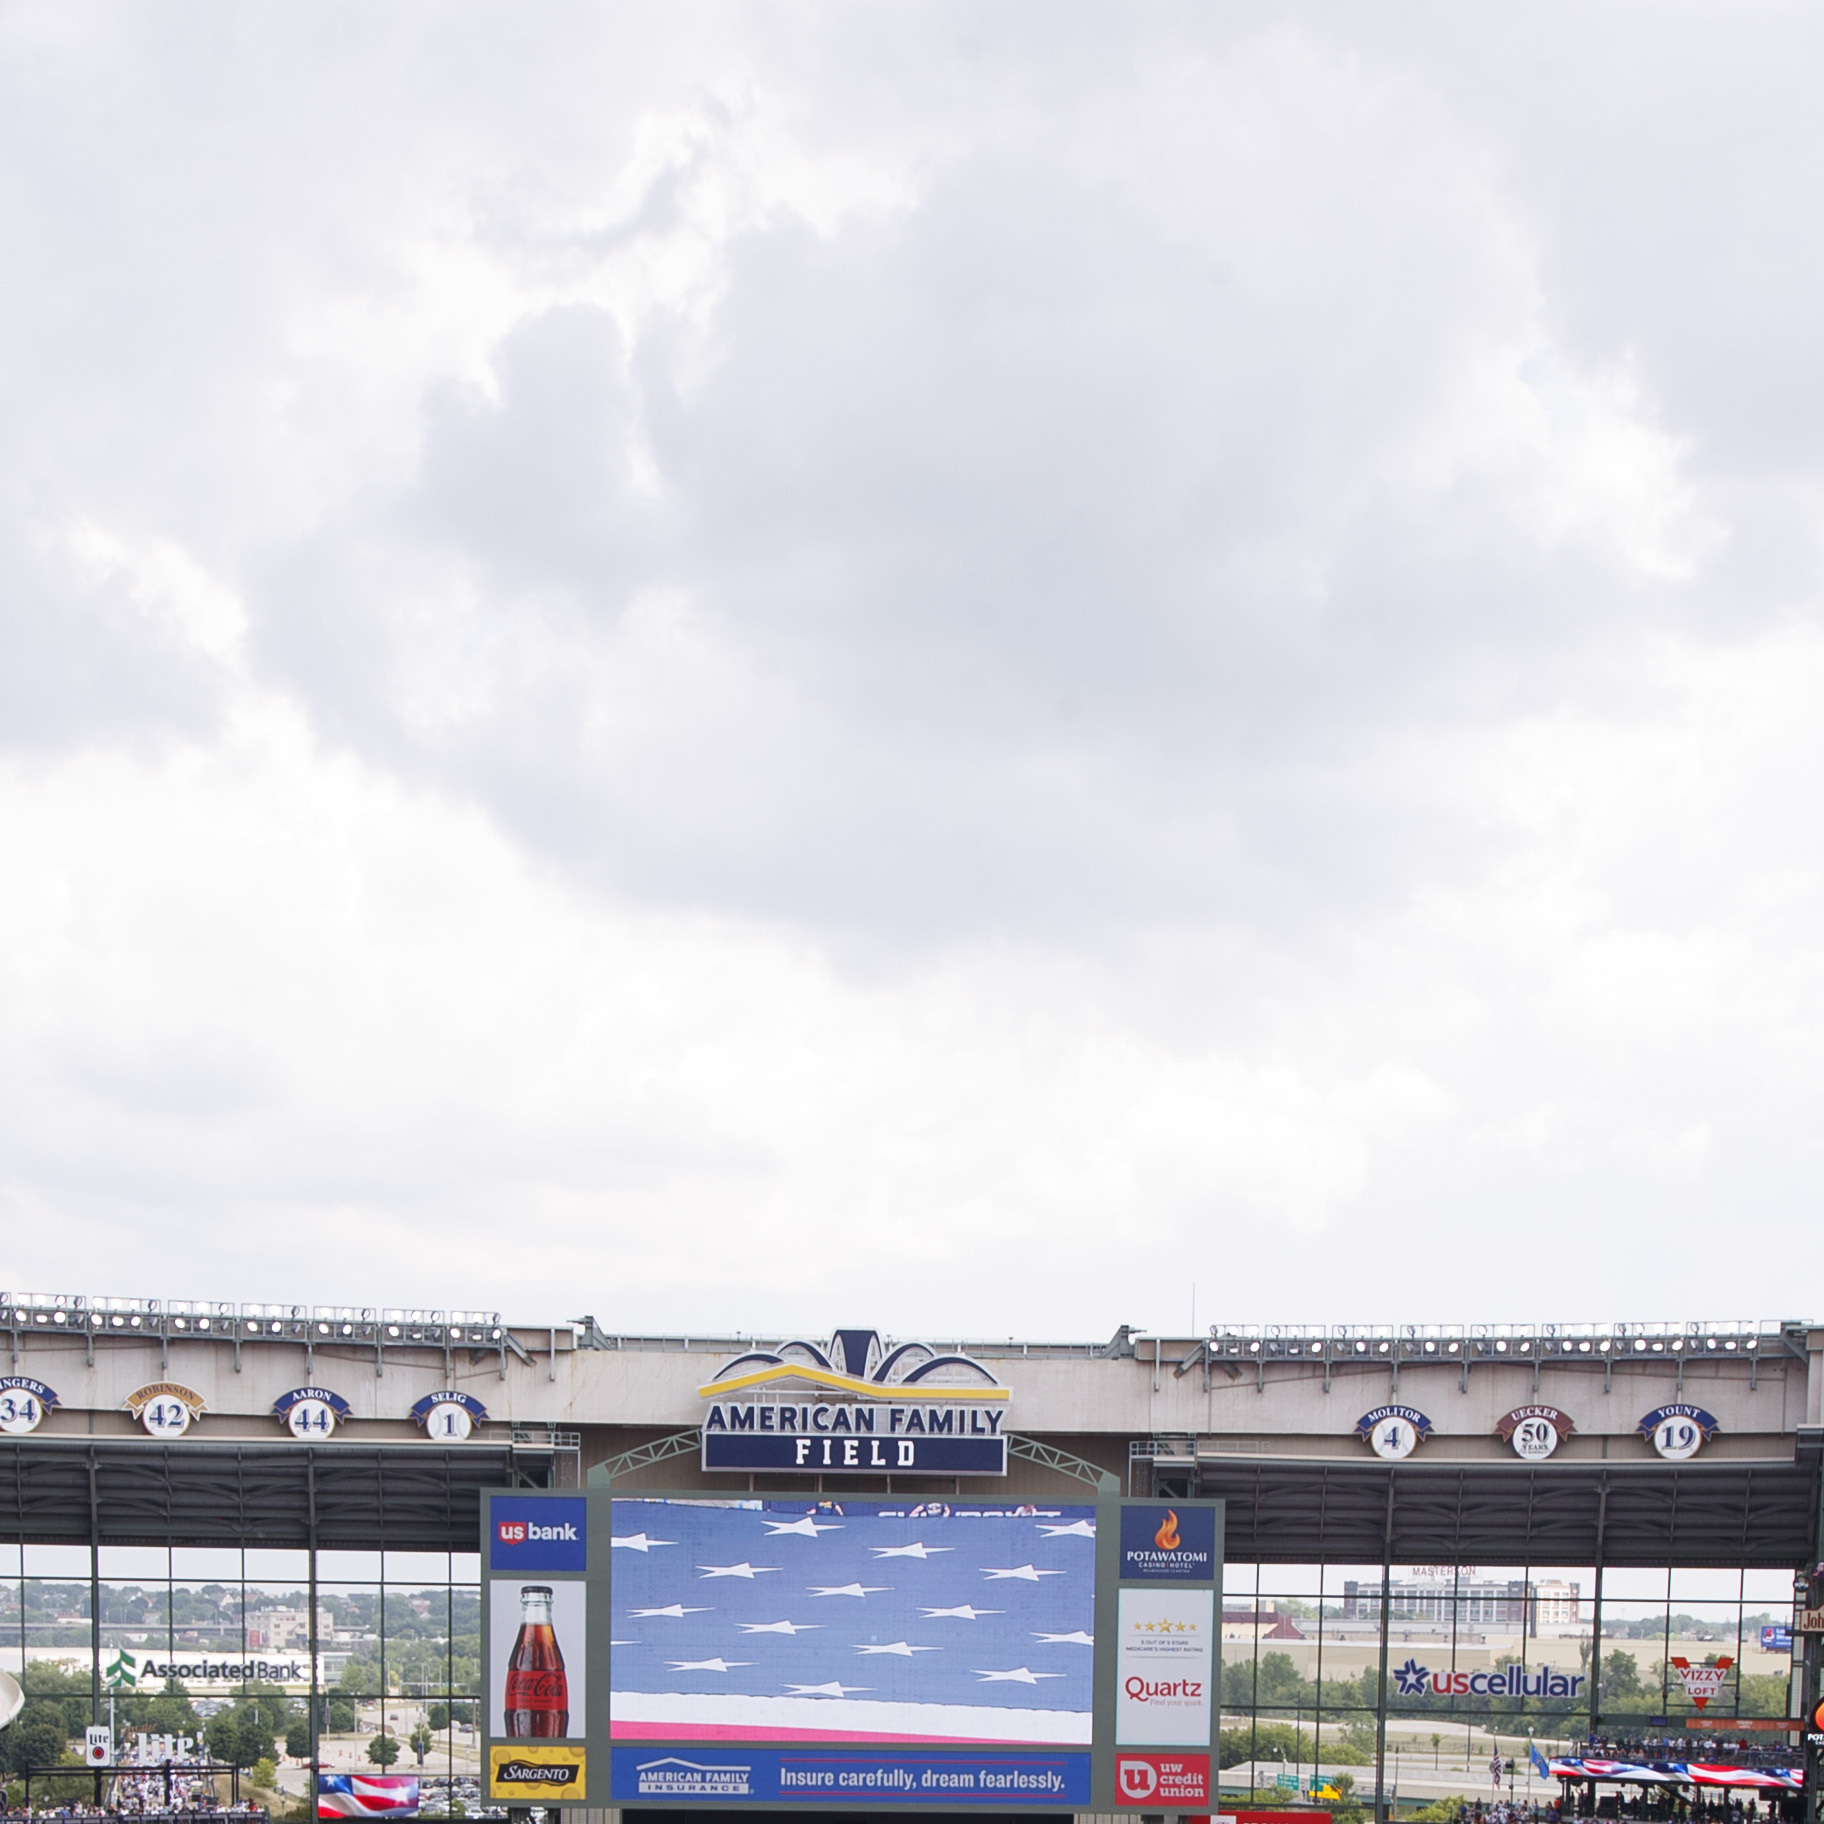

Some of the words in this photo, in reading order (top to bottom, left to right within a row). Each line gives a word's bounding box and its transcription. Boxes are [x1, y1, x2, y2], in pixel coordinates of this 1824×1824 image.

[136, 1385, 195, 1400] ROBINSON
[292, 1388, 332, 1402] AARON
[431, 1391, 467, 1404] SELIG
[0, 1398, 36, 1424] 34
[149, 1403, 185, 1428] 42
[706, 1404, 875, 1432] AMERICAN
[889, 1407, 1004, 1434] FAMILY
[1367, 1406, 1421, 1423] MOLITOR
[1511, 1406, 1559, 1422] UECKER
[1658, 1405, 1700, 1418] YOUNT
[294, 1408, 329, 1432] 44
[443, 1412, 457, 1437] 1
[1383, 1426, 1400, 1450] 4
[1521, 1422, 1550, 1443] 50
[1661, 1425, 1696, 1450] 19
[795, 1438, 915, 1466] FIELD
[1126, 1551, 1207, 1562] POTAWATOMI
[1432, 1666, 1585, 1696] uscellular
[1679, 1670, 1726, 1681] VIZZY
[1125, 1676, 1202, 1702] Quartz
[1687, 1686, 1717, 1695] LOFT
[89, 1734, 109, 1745] Lite
[504, 1765, 569, 1782] SARGENTO
[1160, 1763, 1183, 1772] uw
[639, 1771, 701, 1782] AMERICAN
[706, 1772, 749, 1783] FAMILY
[780, 1767, 834, 1786] Insure
[838, 1769, 917, 1790] carefully,
[921, 1769, 974, 1788] dream
[978, 1770, 1065, 1790] fearlessly.
[1160, 1773, 1203, 1785] credit
[647, 1784, 740, 1792] INSURANCE
[1159, 1786, 1204, 1797] union
